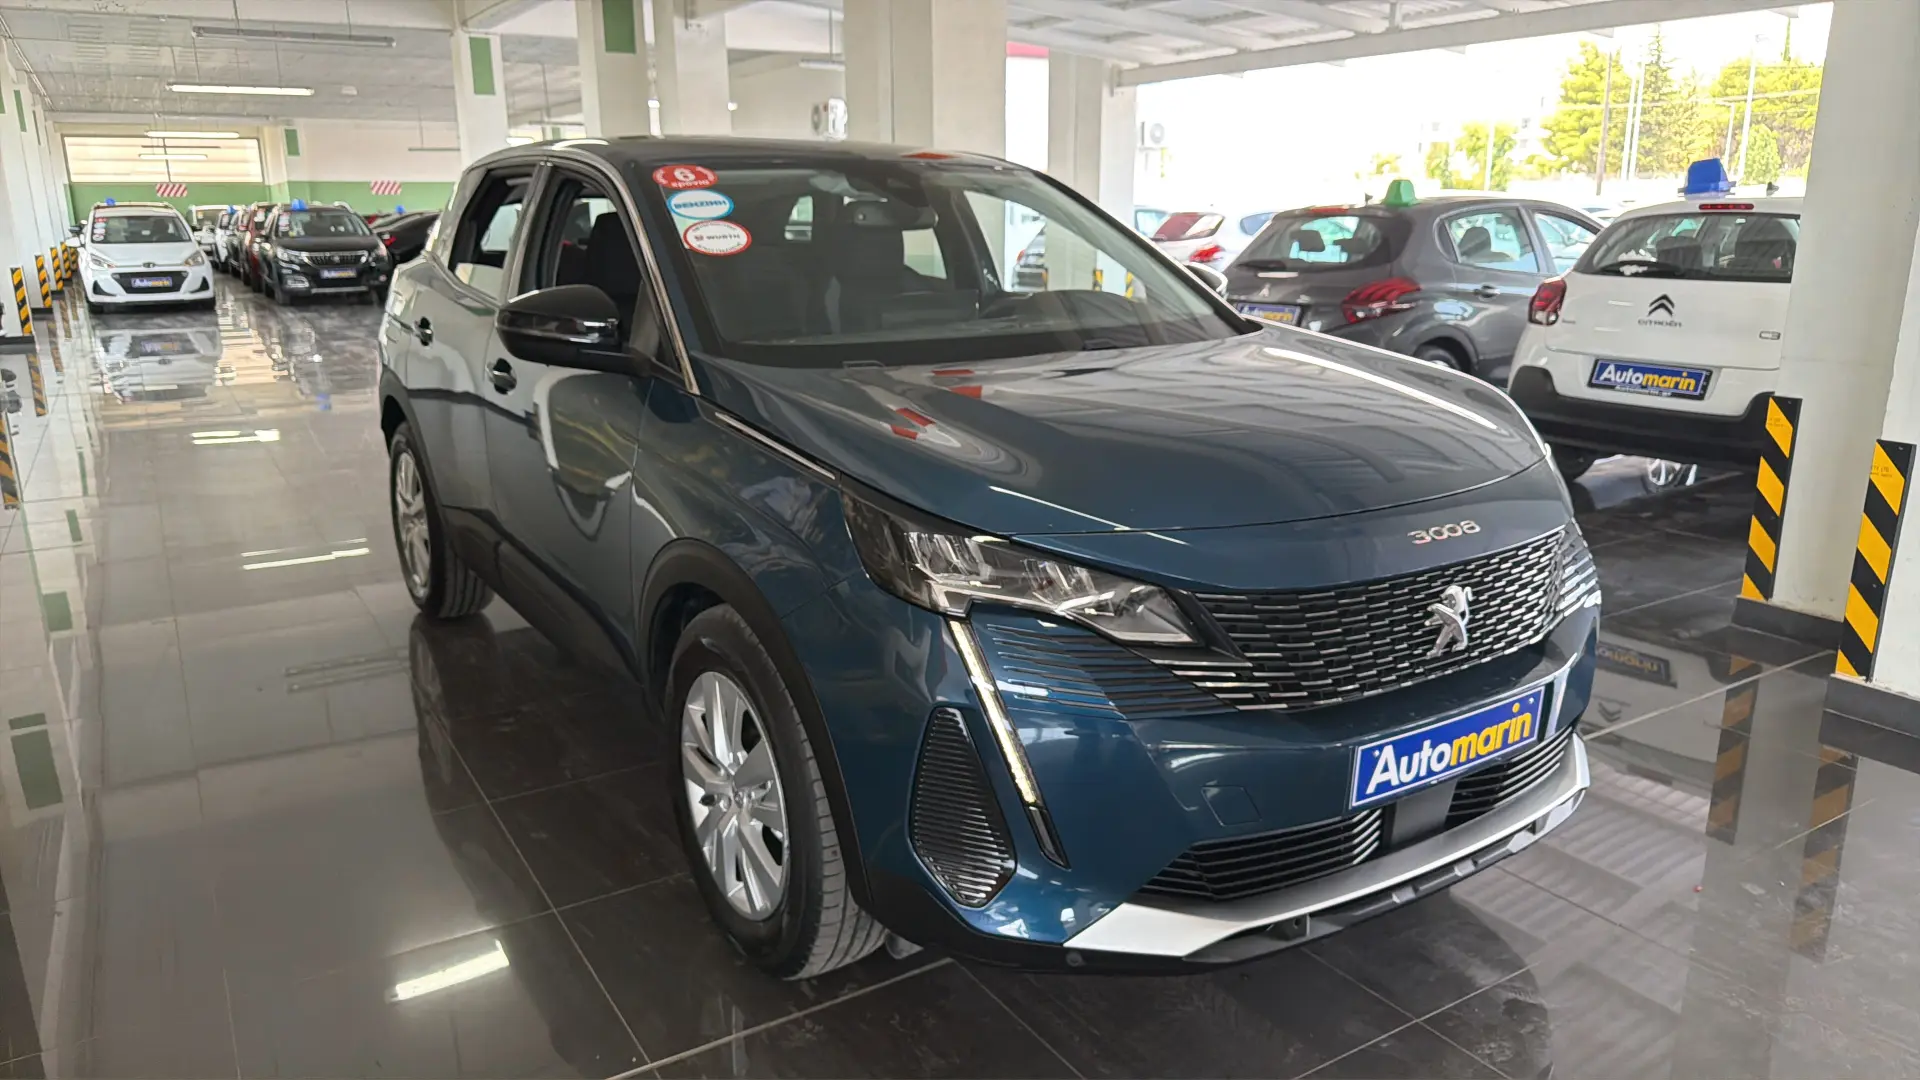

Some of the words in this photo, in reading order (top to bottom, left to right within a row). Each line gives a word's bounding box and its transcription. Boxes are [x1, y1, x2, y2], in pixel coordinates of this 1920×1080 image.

[673, 167, 696, 181] 6
[1759, 330, 1781, 340] C3
[1600, 364, 1696, 392] Automarin
[1407, 520, 1481, 544] 3008
[1366, 702, 1532, 795] Automarin
